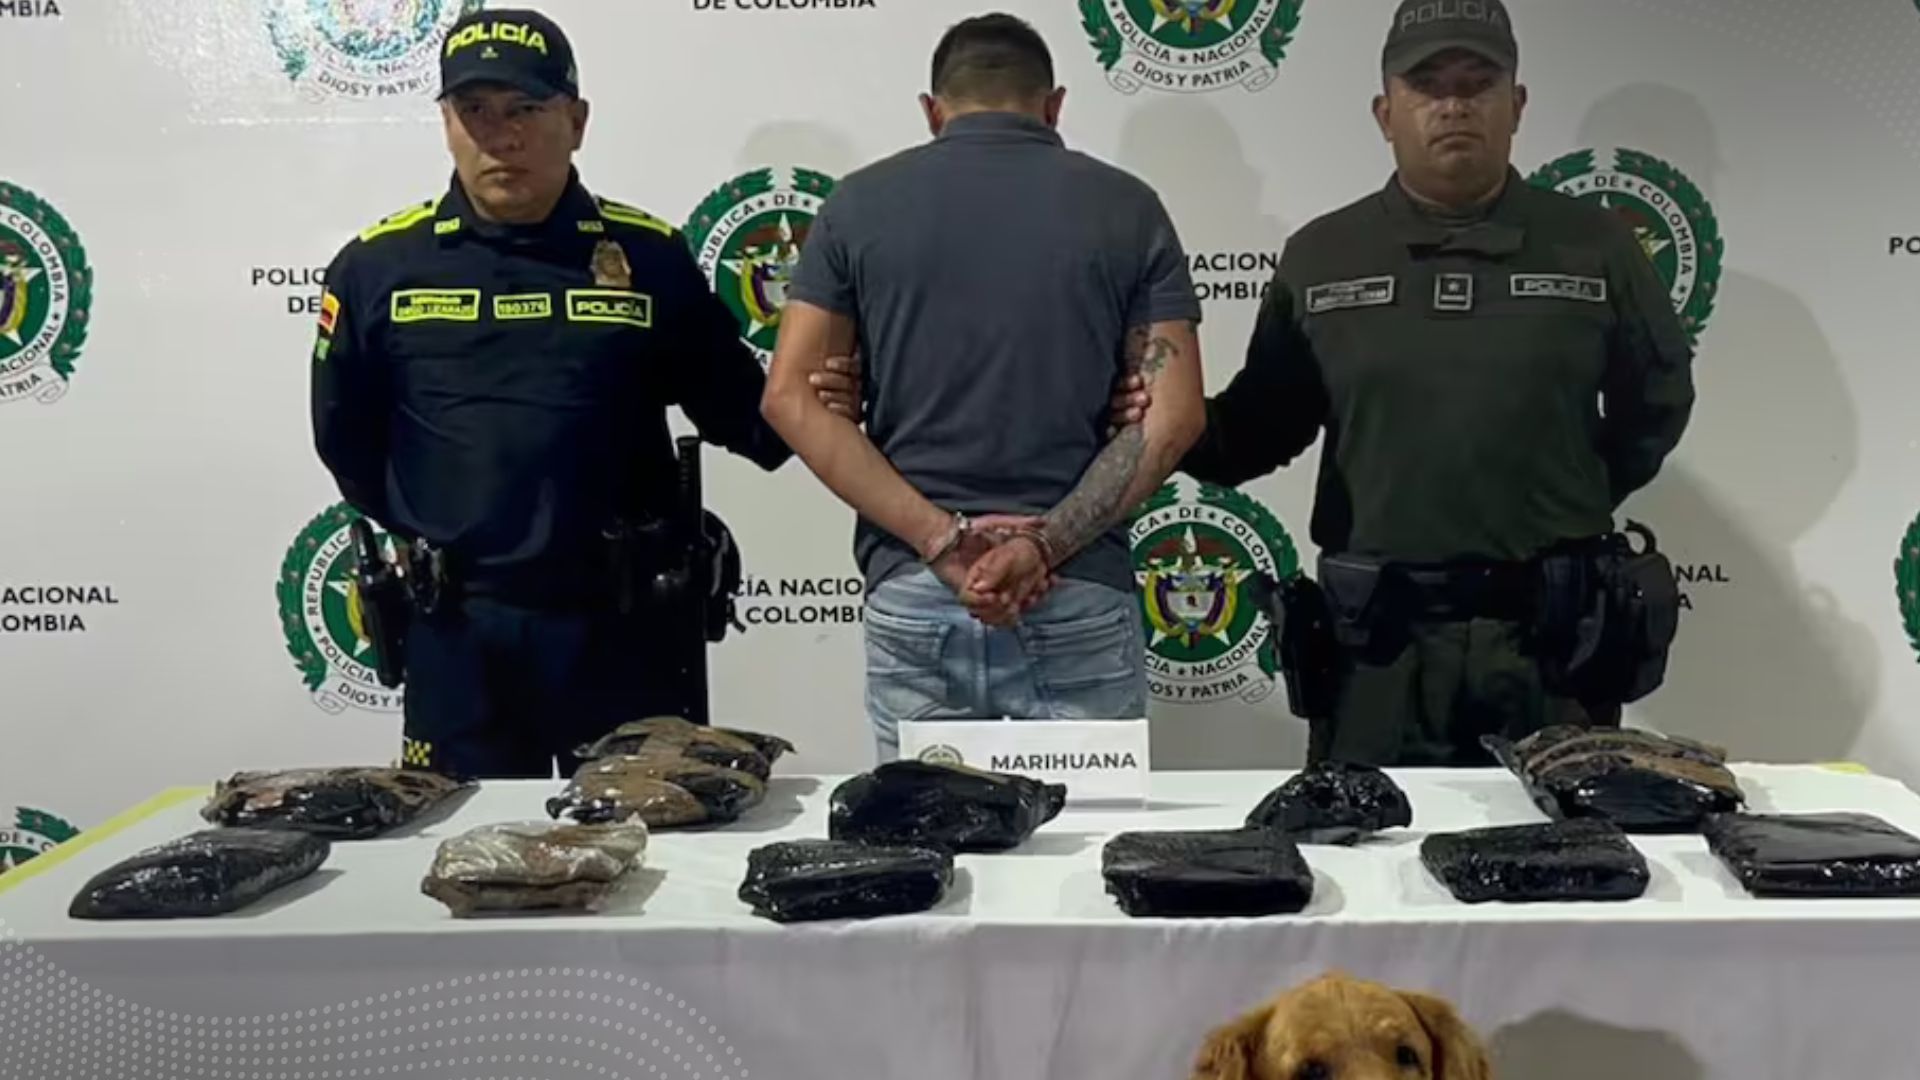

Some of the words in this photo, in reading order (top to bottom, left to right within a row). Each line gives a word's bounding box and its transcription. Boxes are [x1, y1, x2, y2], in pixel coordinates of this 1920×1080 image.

[1193, 8, 1271, 65] NACIONAL
[1191, 60, 1251, 87] PATRIA
[1639, 184, 1693, 275] COLOMBIA
[7, 213, 65, 304] COLOMBIA
[1179, 507, 1202, 519] DE
[0, 614, 86, 632] OMBIA
[1191, 621, 1268, 676] NACIONAL
[1191, 672, 1249, 698] PATRIA
[991, 752, 1137, 771] MARIHUANA
